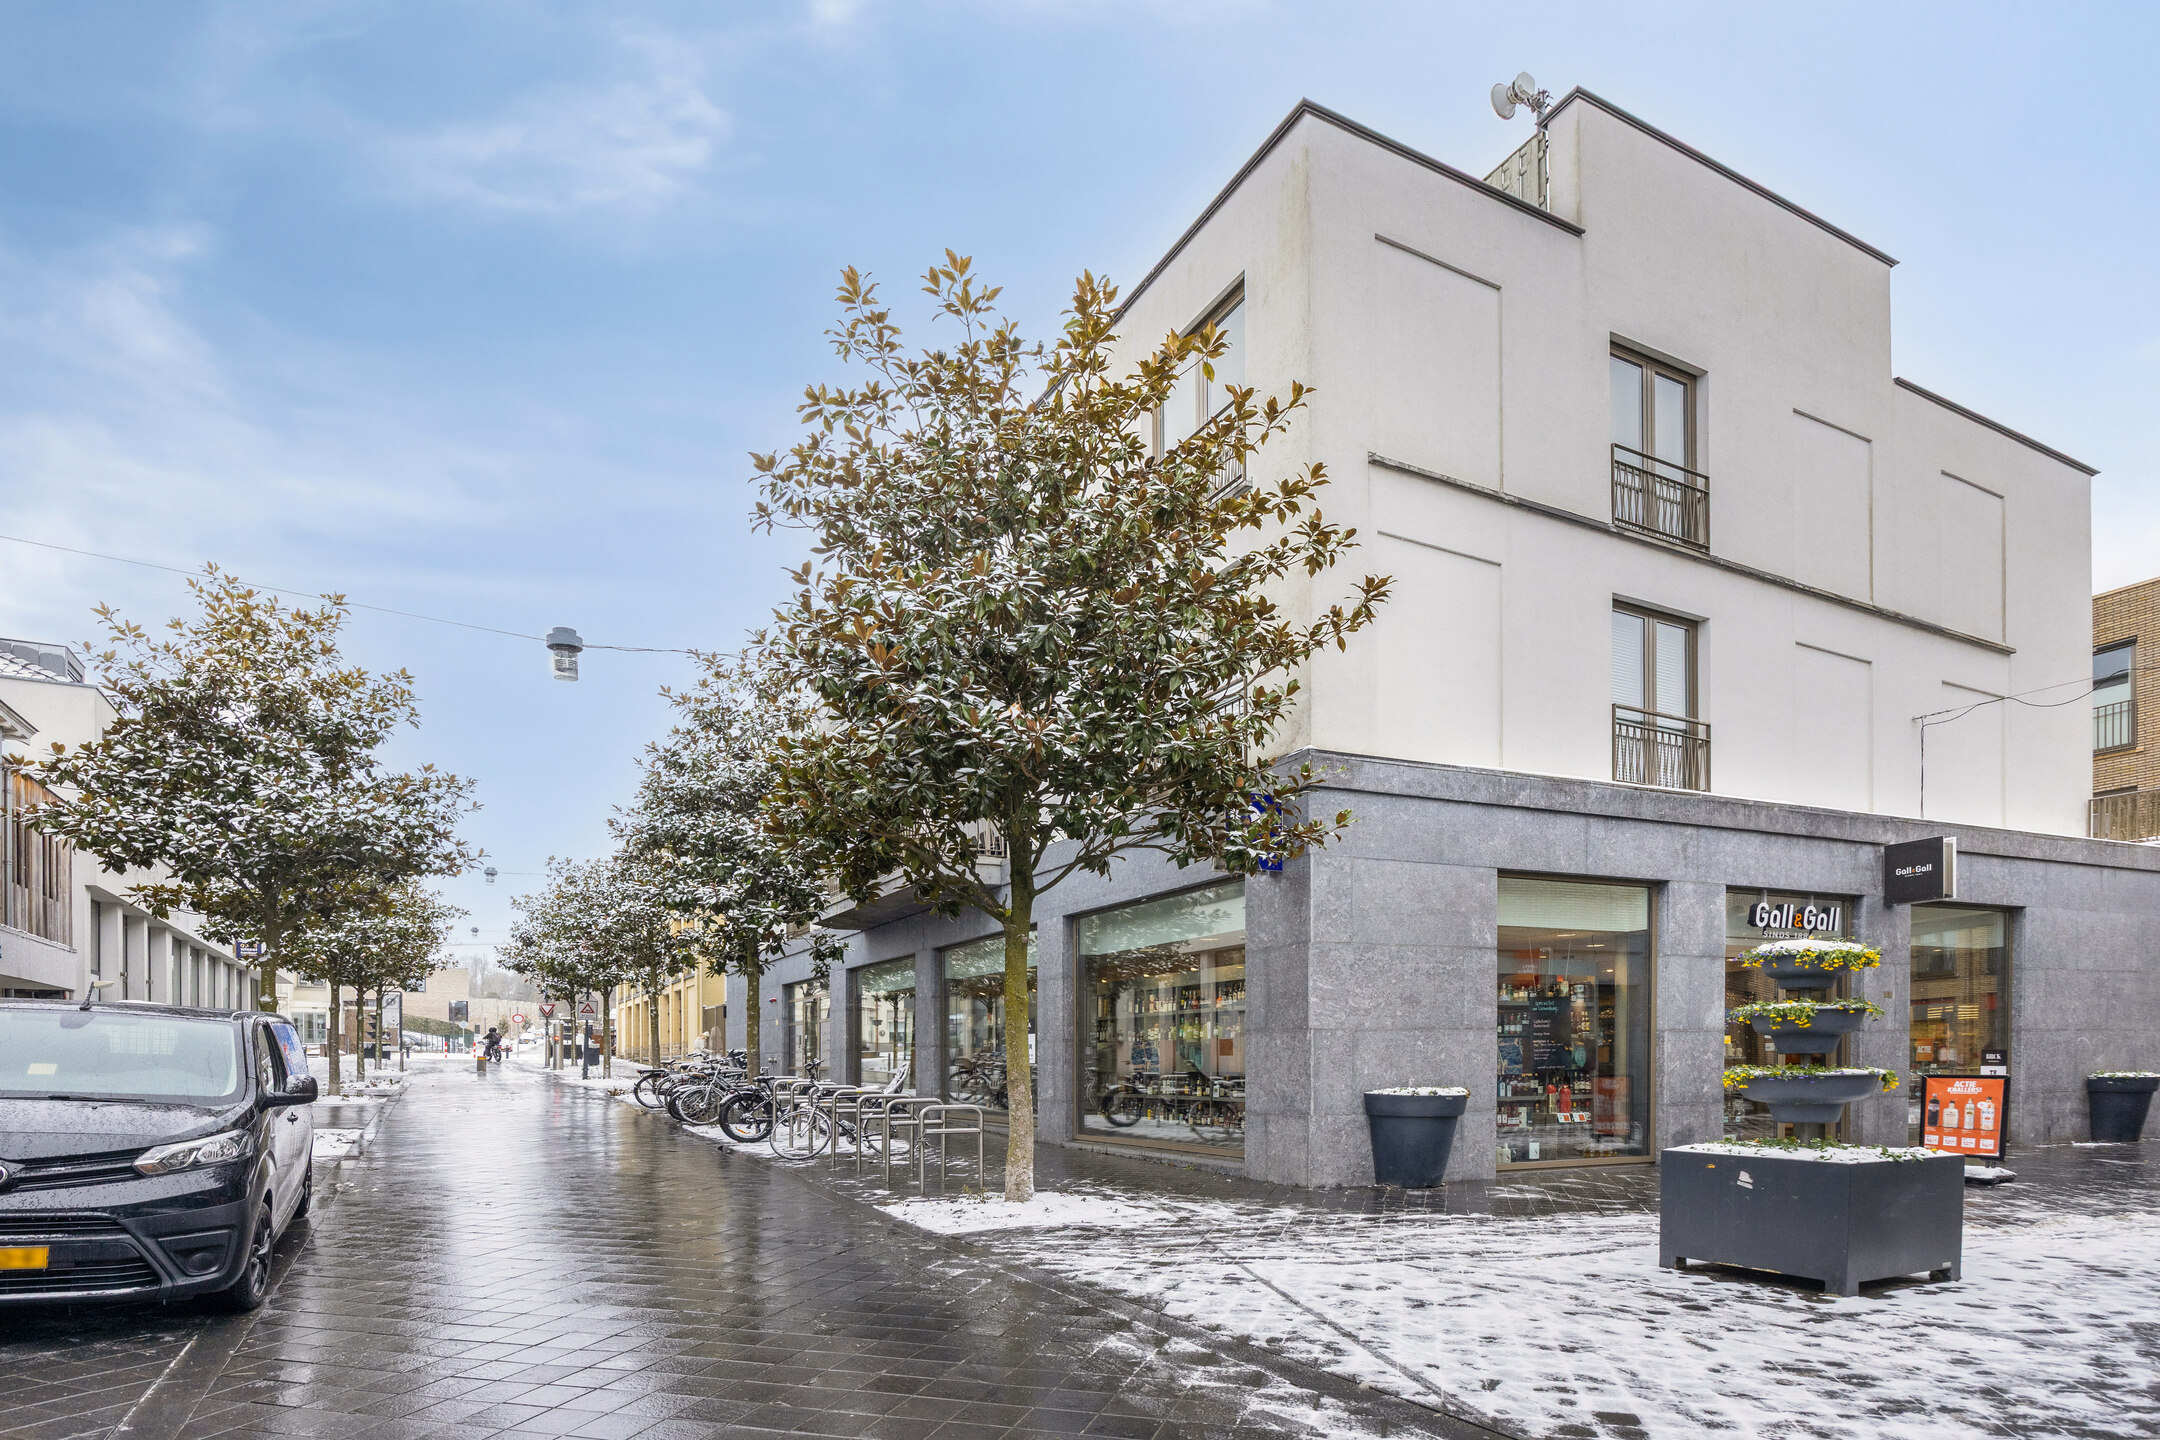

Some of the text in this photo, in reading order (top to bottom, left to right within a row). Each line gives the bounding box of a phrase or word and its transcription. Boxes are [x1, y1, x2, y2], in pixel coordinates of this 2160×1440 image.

[1763, 930, 1812, 940] SINDS 188
[1917, 1045, 1931, 1053] ACTIE
